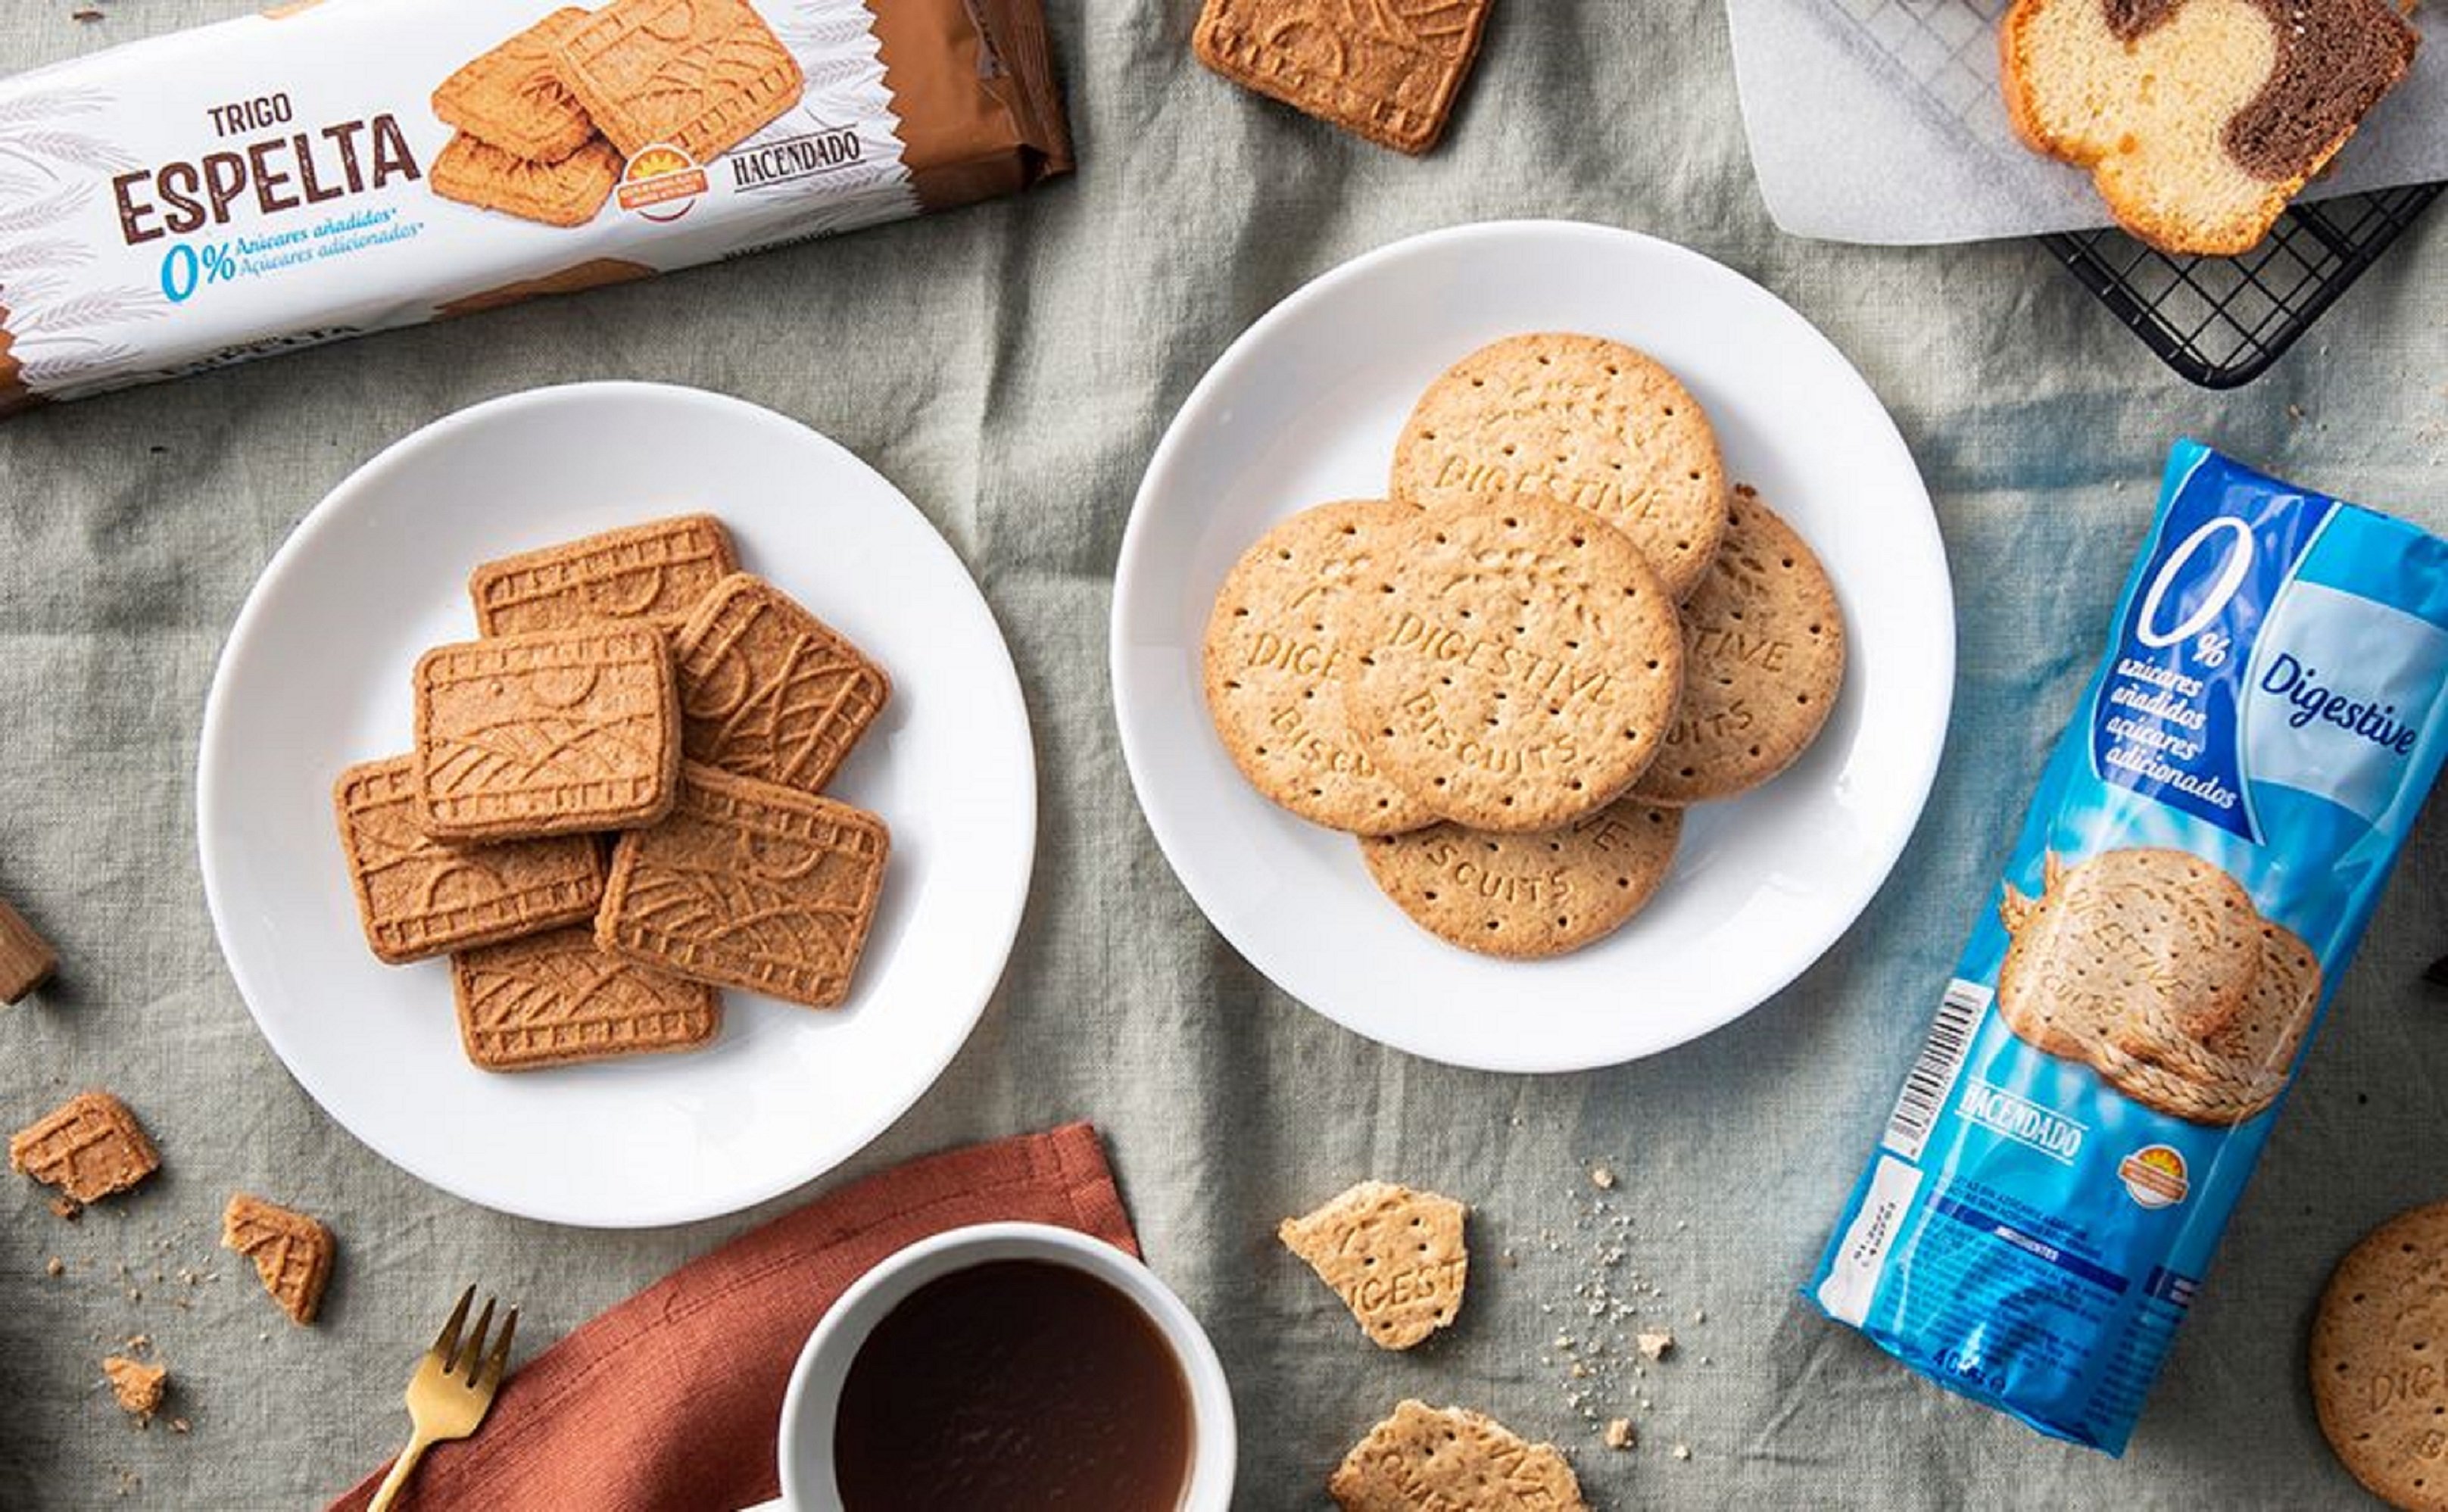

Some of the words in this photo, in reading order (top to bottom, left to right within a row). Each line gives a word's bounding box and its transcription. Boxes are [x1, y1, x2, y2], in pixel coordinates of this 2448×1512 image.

[207, 93, 292, 137] TRIGO
[112, 113, 422, 245] ESPELTA
[732, 131, 861, 185] HACENDADO
[161, 242, 236, 304] 0%
[1435, 455, 1661, 519] DIGESTIVE
[2137, 516, 2253, 667] 0%
[1389, 611, 1614, 706] DIGESTIVE
[1403, 687, 1576, 774] BISCUITS
[2111, 683, 2206, 730] añadidos
[2262, 652, 2417, 756] Digestive
[2105, 744, 2238, 809] adicionados
[1959, 1083, 2082, 1158] HACENDADO
